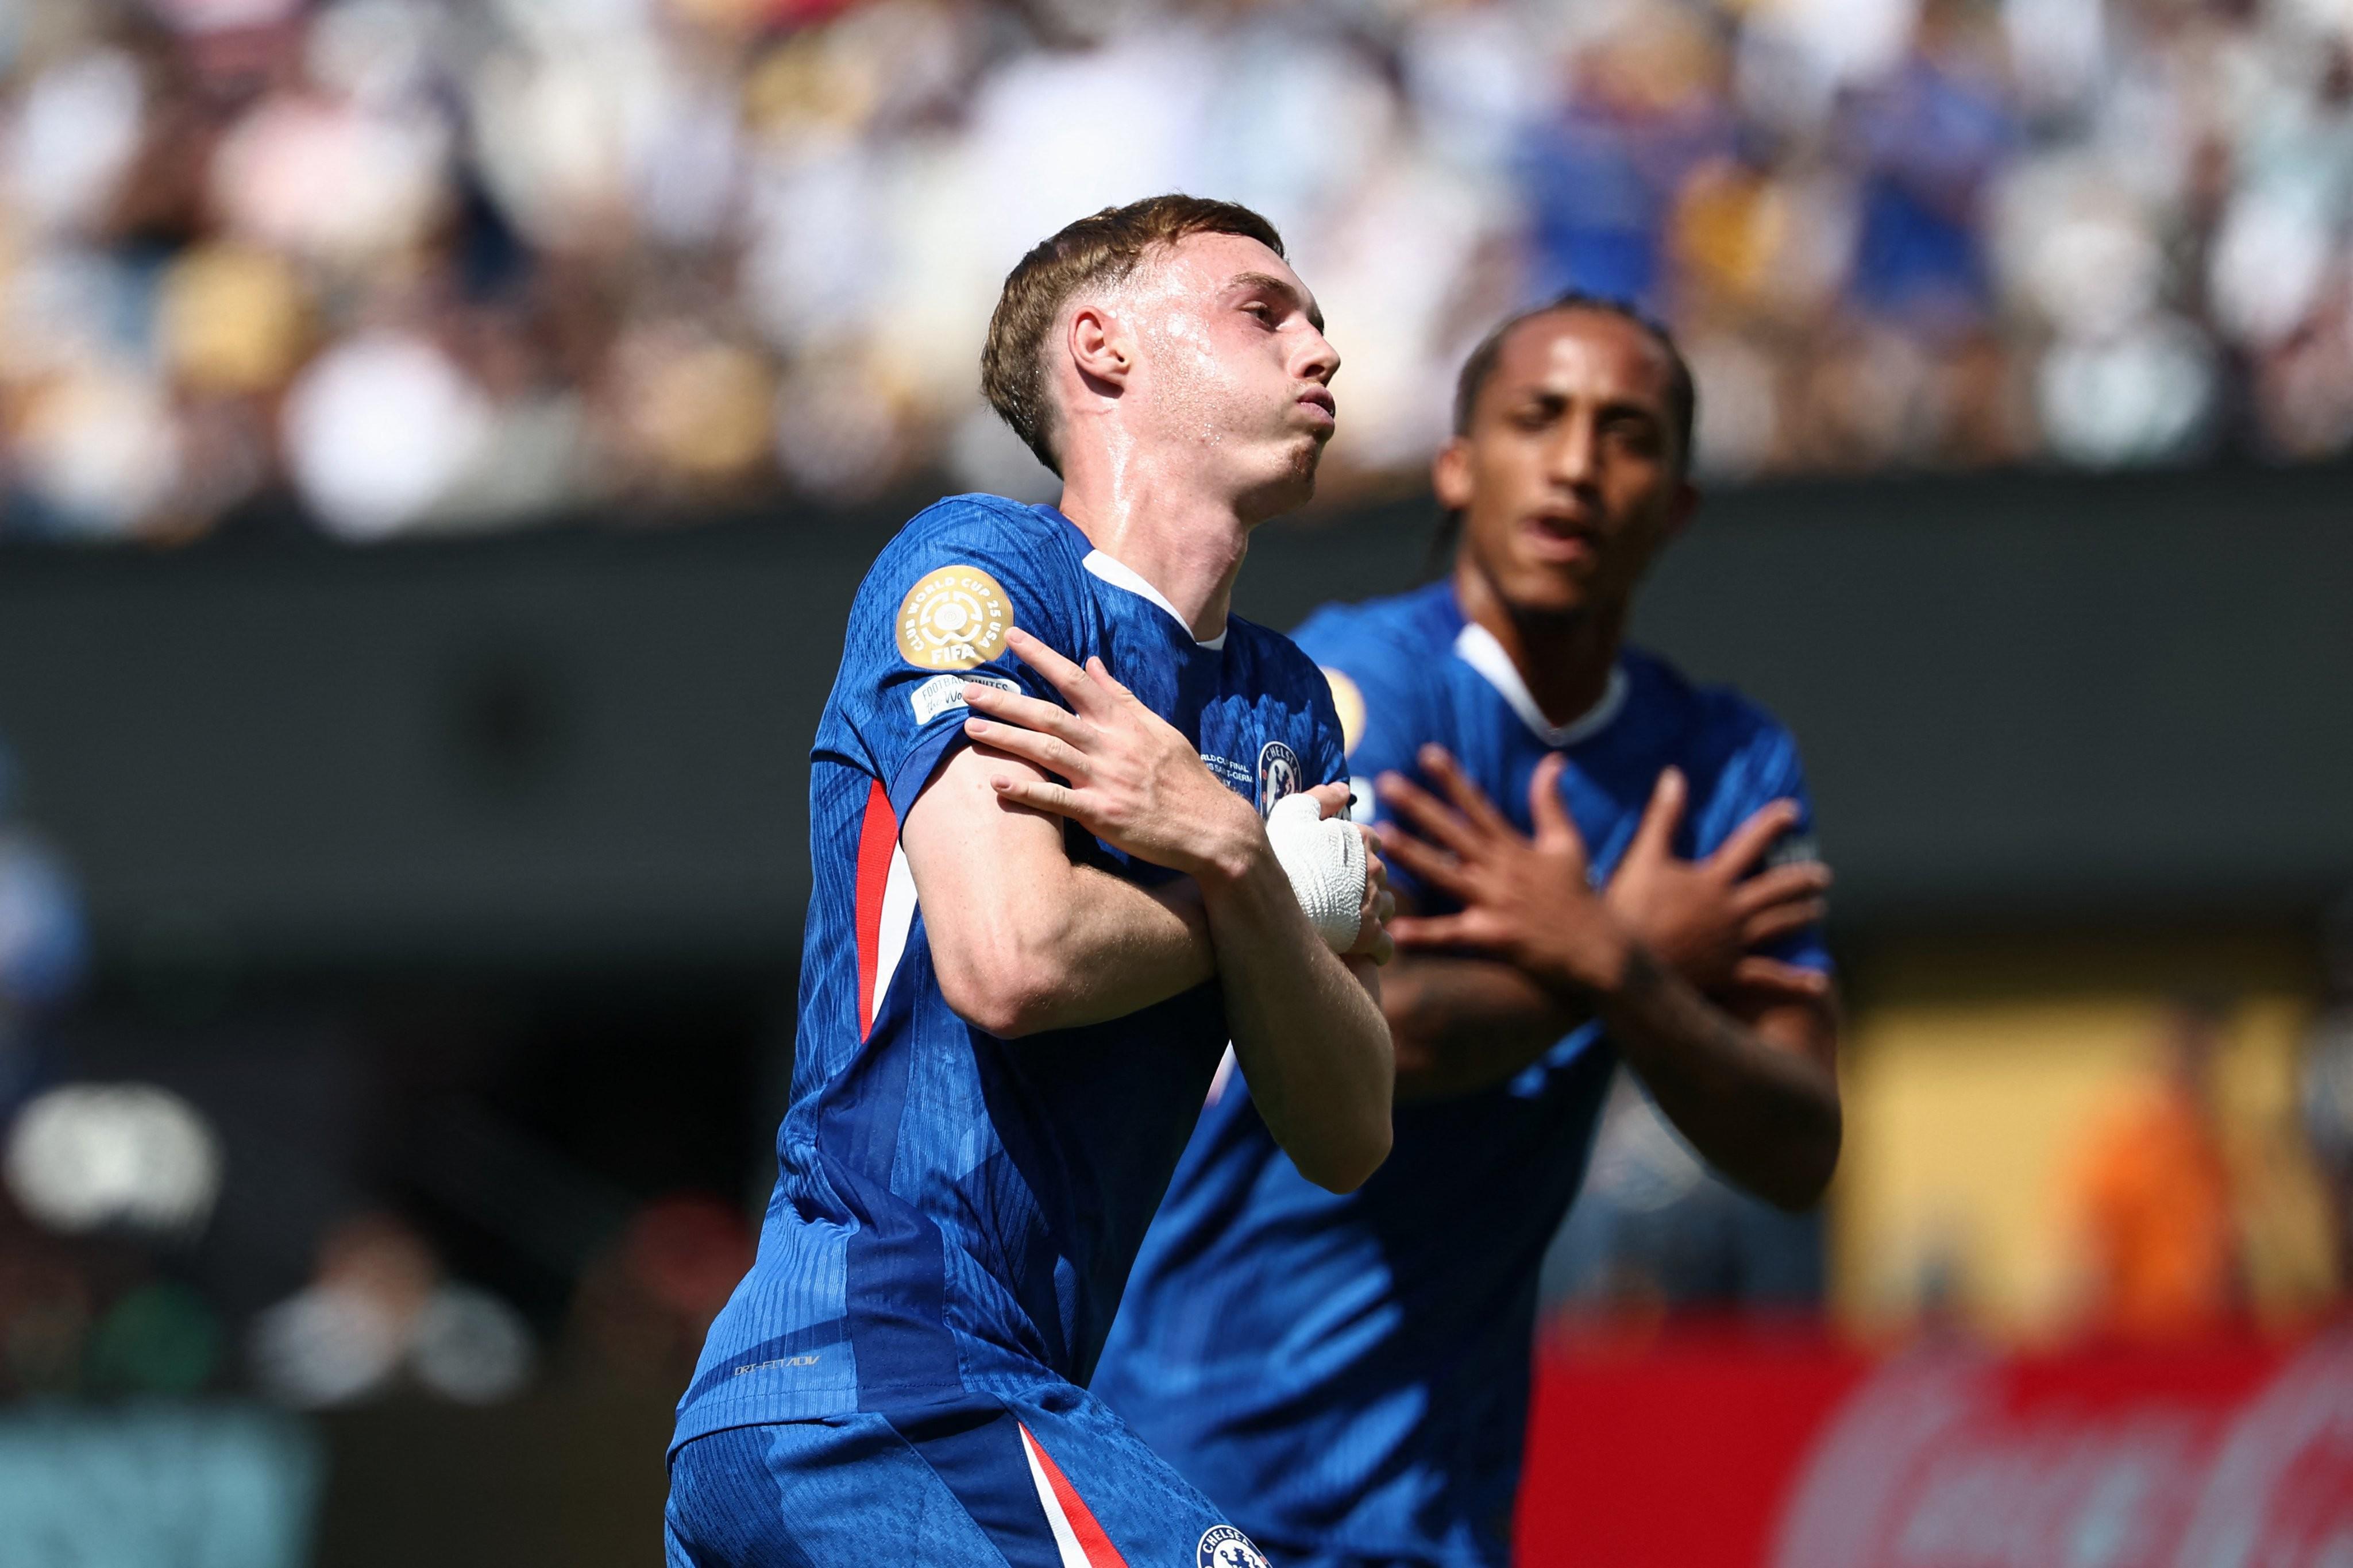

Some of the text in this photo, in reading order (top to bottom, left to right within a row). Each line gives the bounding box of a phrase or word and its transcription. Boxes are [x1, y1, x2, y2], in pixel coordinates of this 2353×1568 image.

[905, 577, 1001, 651] CLUB WORLD CUP 25 USA
[931, 644, 975, 664] FIFA
[1217, 756, 1229, 764] CU
[1230, 762, 1249, 773] FINAL
[1202, 1529, 1248, 1553] CHELSEA
